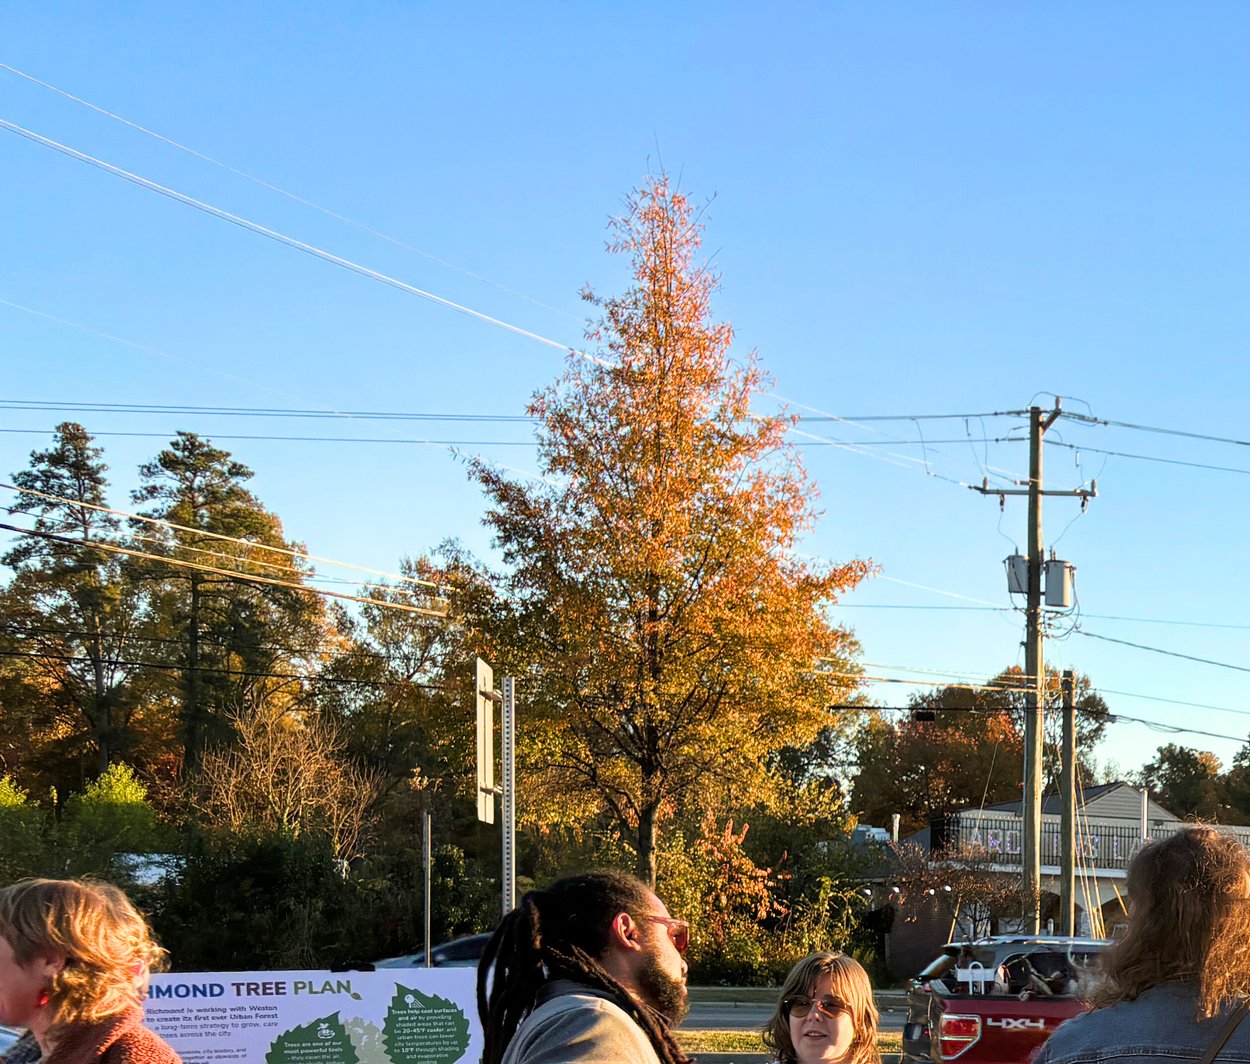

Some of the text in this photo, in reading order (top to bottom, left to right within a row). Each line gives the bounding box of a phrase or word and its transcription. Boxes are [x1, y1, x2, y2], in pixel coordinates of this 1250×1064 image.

[970, 828, 1022, 854] ARC
[147, 980, 351, 999] HMOND TREE PLAN
[987, 1018, 1044, 1029] 4X4
